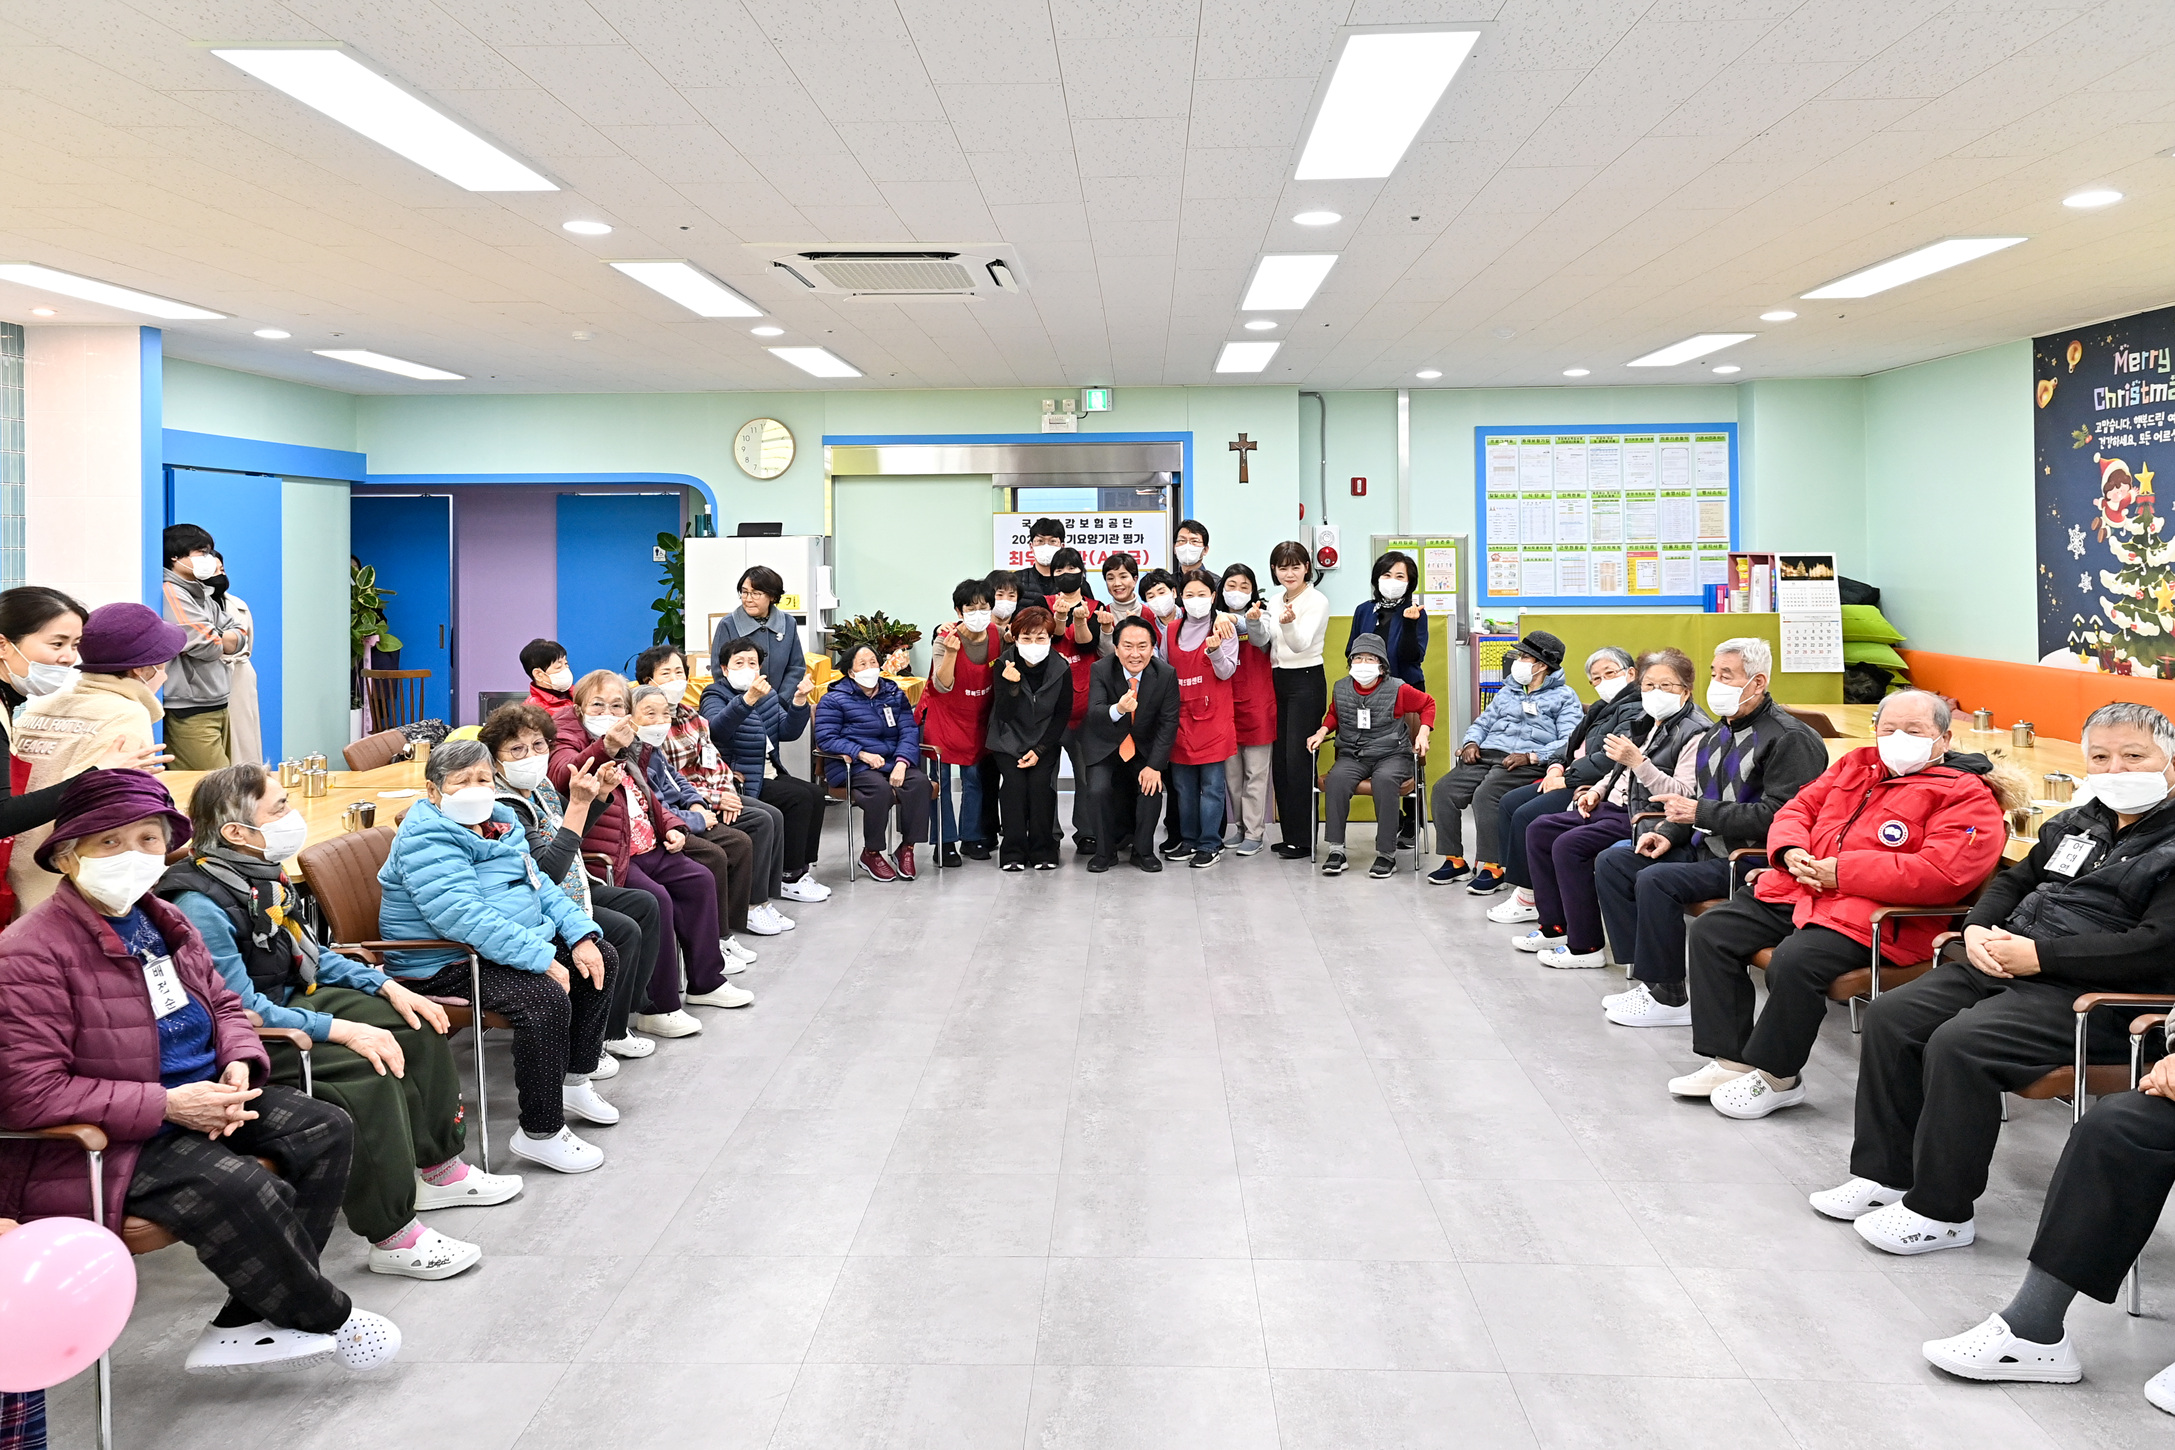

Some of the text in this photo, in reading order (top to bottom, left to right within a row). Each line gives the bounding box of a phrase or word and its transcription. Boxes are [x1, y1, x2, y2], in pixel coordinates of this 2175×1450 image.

[2113, 347, 2171, 375] Merry
[2095, 418, 2132, 433] 고맙습니다,
[2134, 412, 2165, 428] 행복드림
[2098, 436, 2137, 450] 건강하세요,
[2139, 431, 2152, 445] 모든
[1022, 518, 1133, 529] 국강보험공단
[1064, 533, 1119, 544] 기요양기관
[1123, 533, 1144, 544] 평가
[17, 738, 58, 754] LEAGUE
